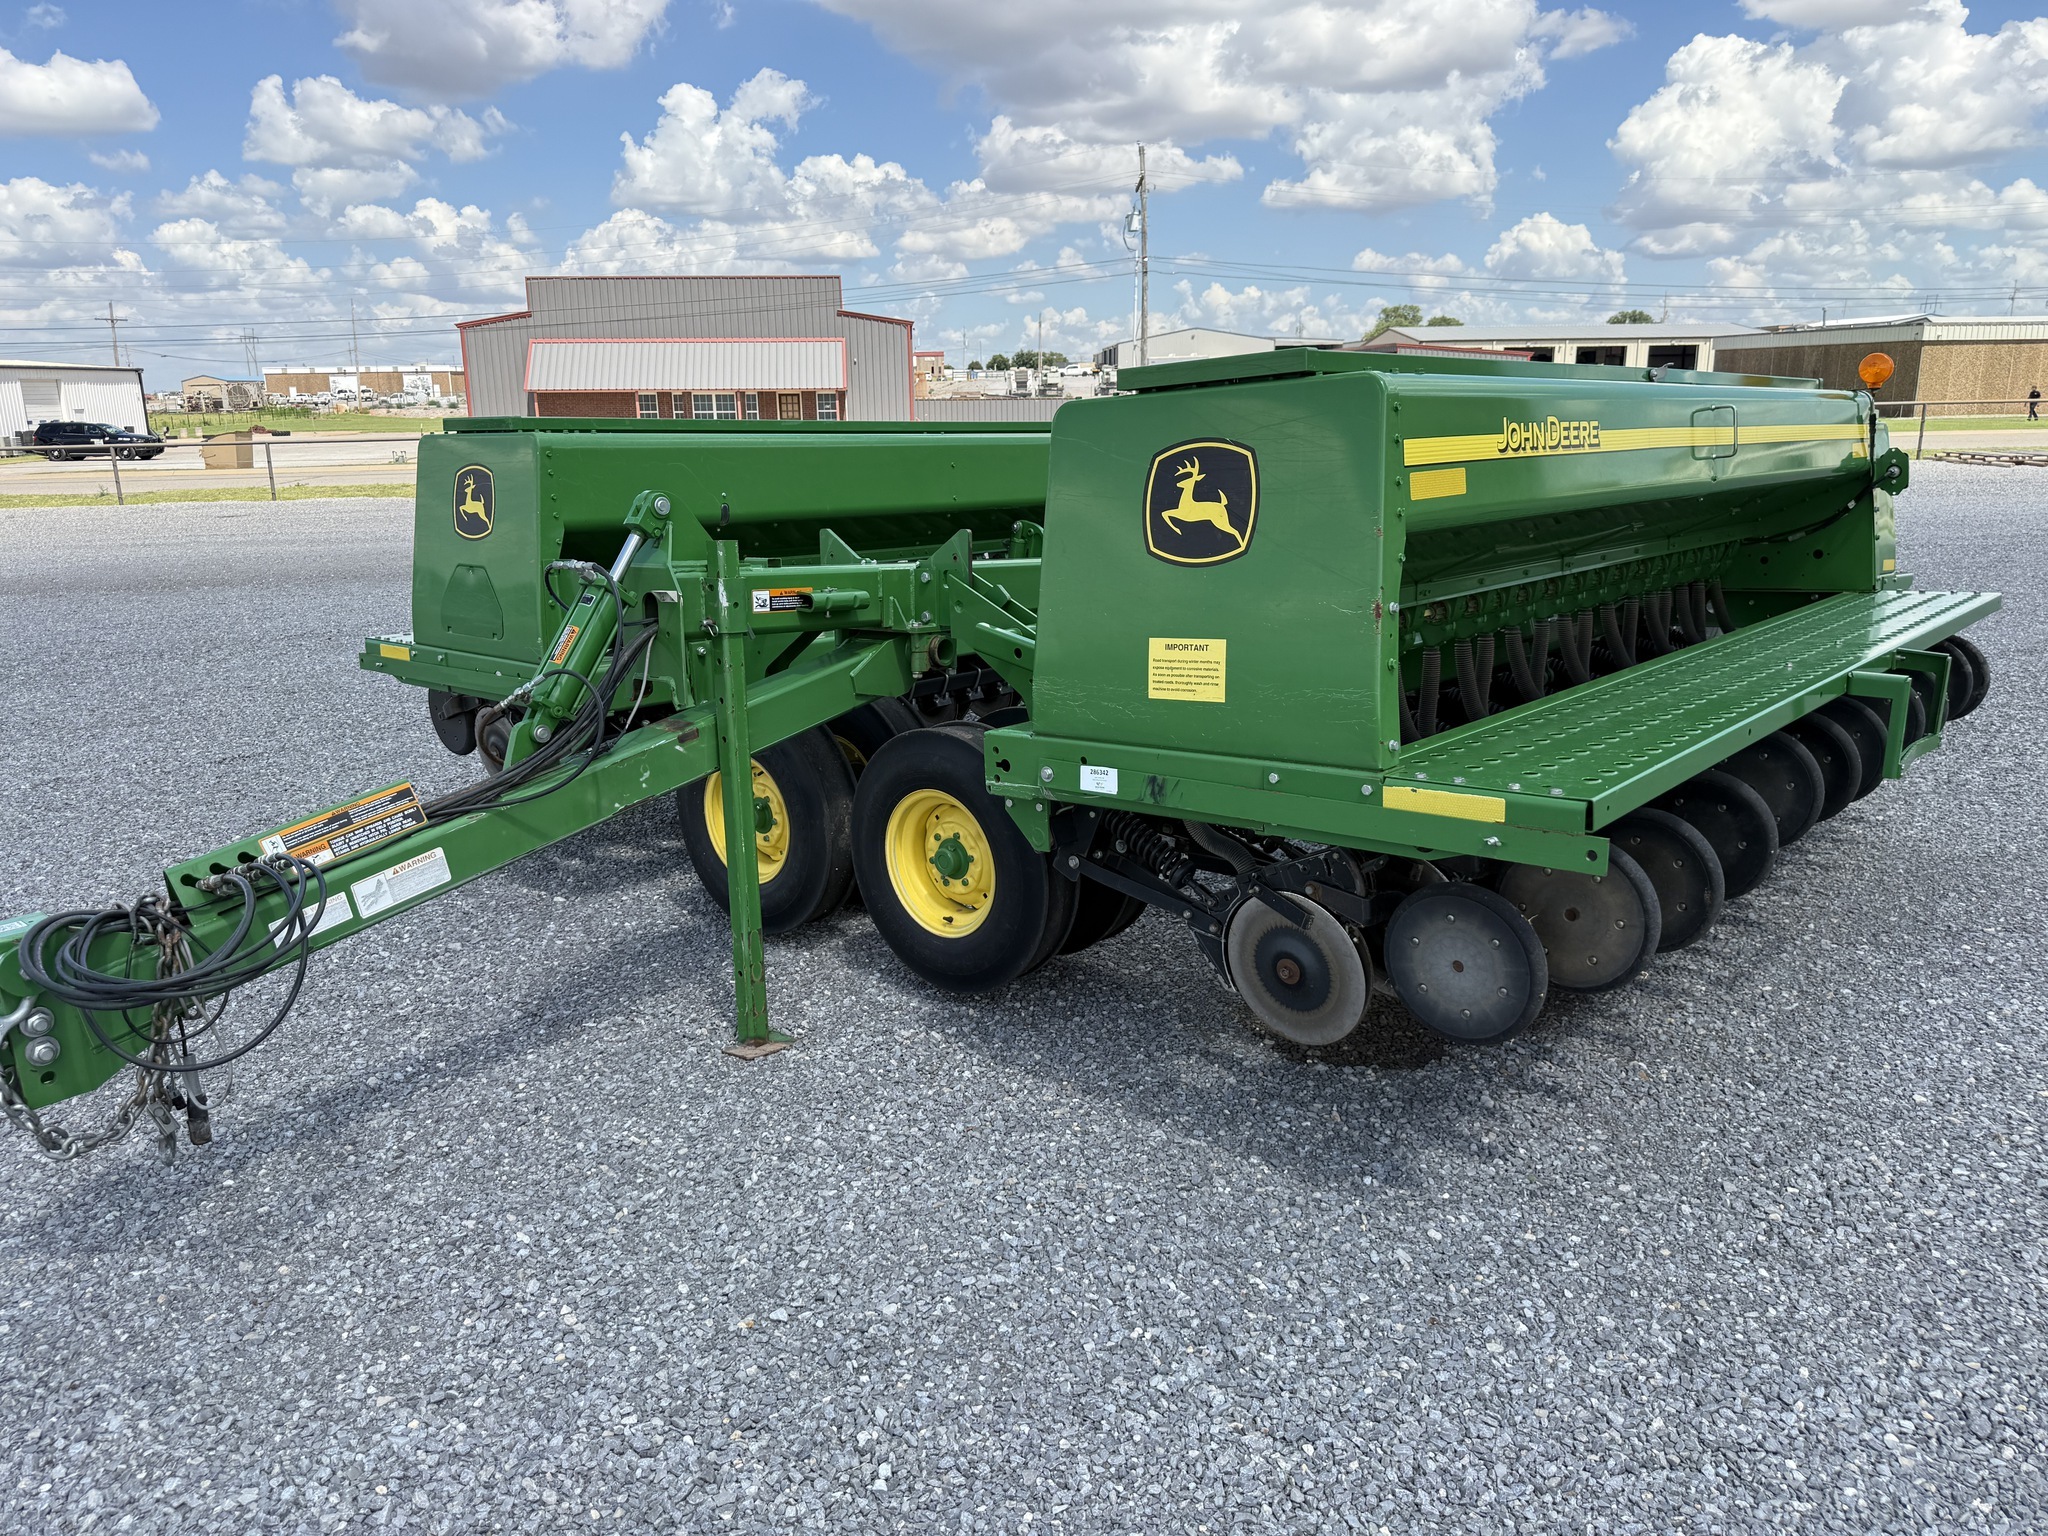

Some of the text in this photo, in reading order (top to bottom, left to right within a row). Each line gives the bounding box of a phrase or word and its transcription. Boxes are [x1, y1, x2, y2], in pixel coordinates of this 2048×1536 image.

[1497, 415, 1600, 453] JOHN DEERE
[557, 634, 575, 661] WARNING
[1090, 768, 1109, 776] 286342
[335, 801, 361, 815] WARNING
[295, 843, 327, 859] WARNING
[398, 851, 437, 872] WARNING
[310, 894, 343, 912] WNING
